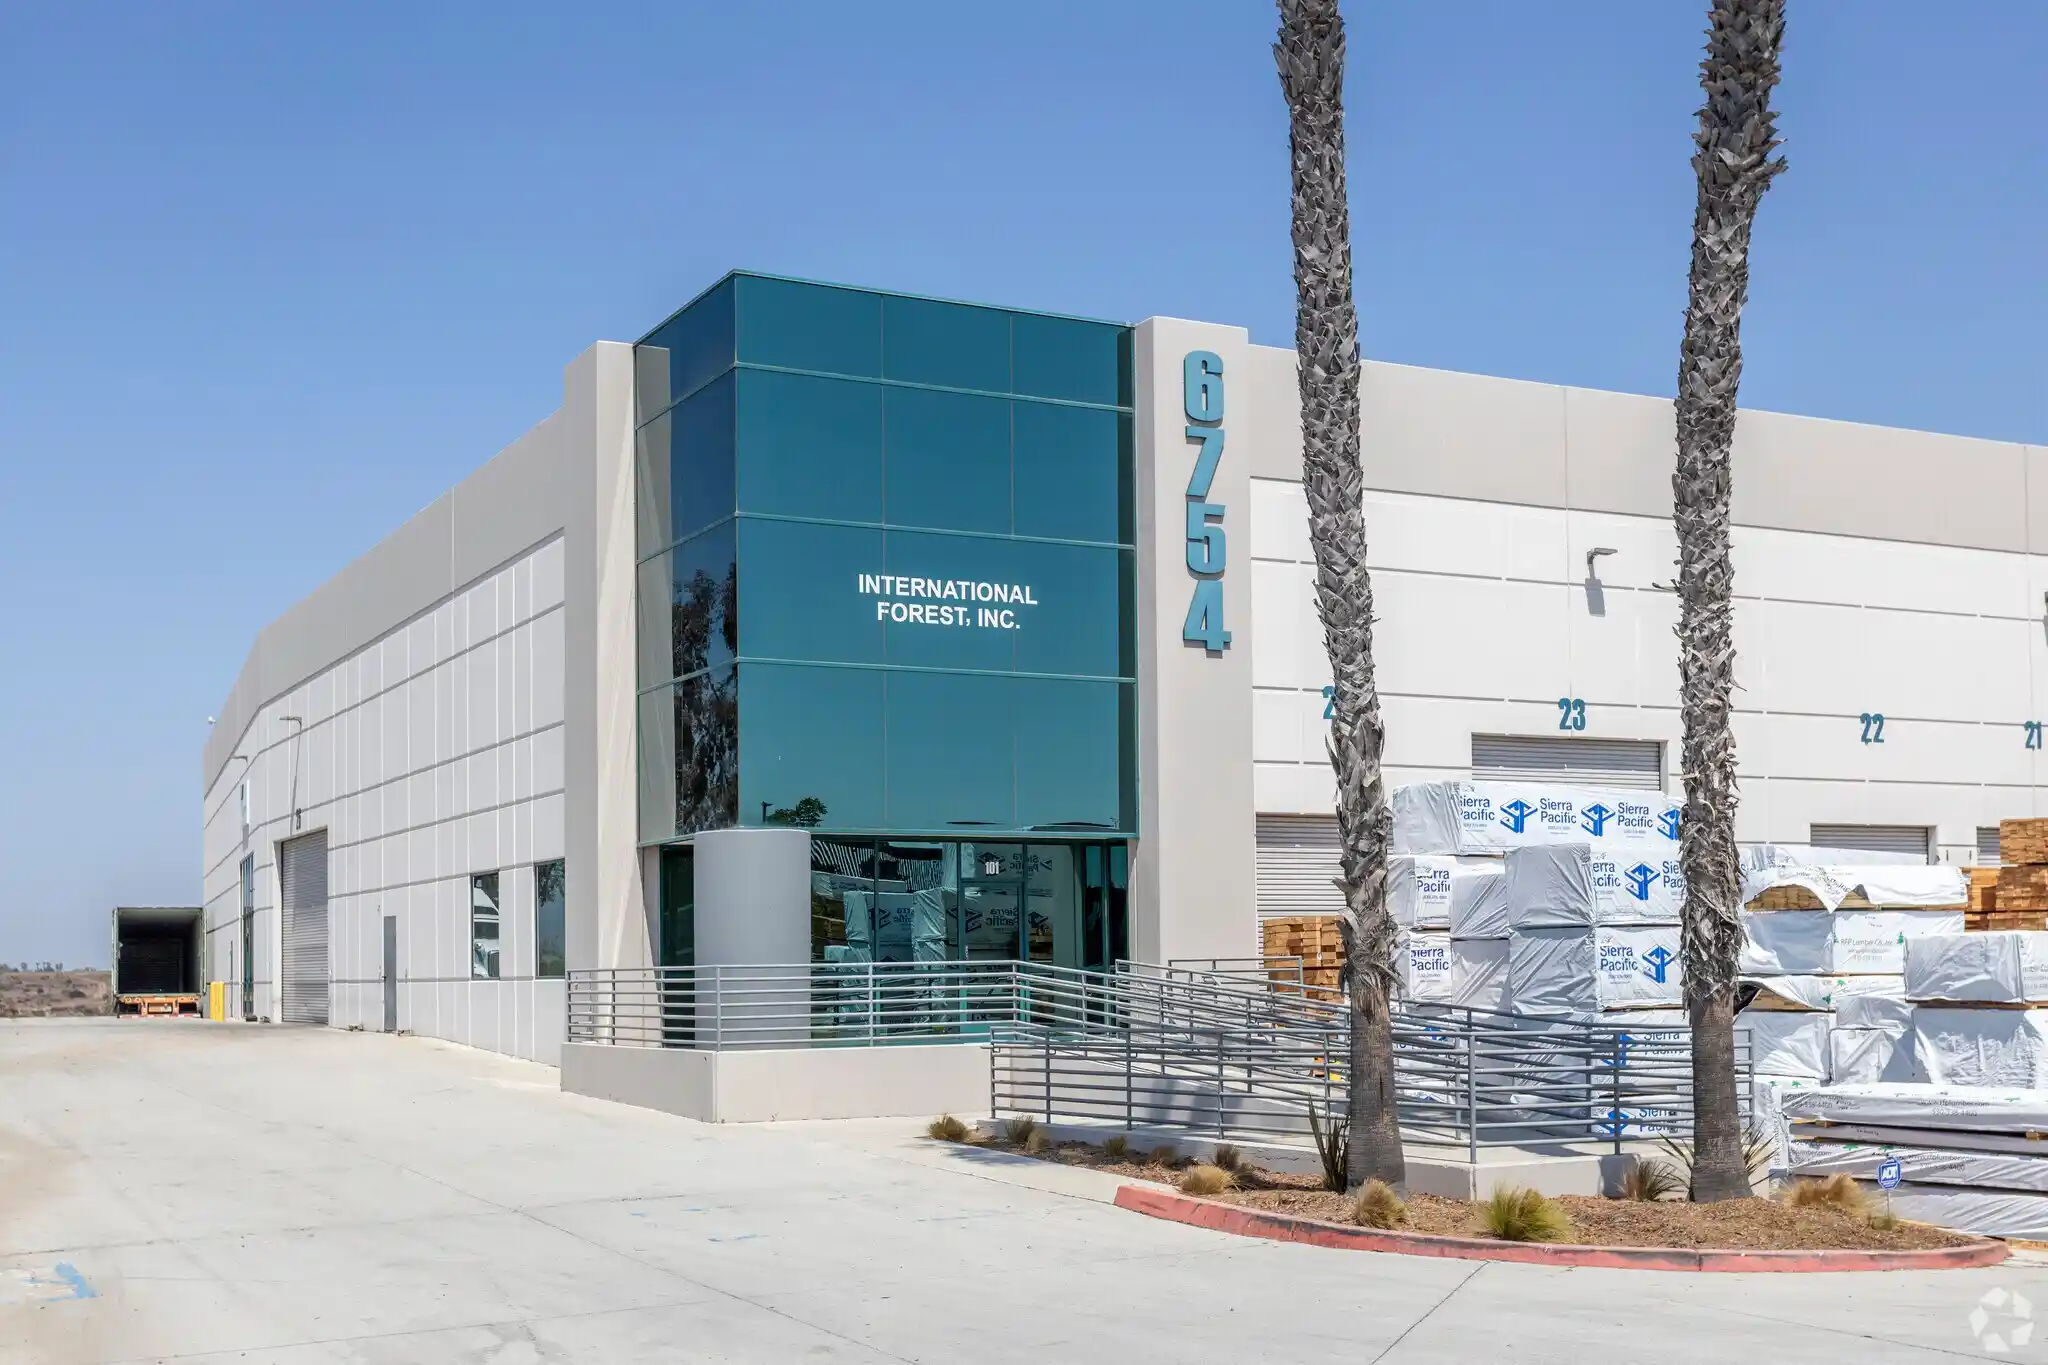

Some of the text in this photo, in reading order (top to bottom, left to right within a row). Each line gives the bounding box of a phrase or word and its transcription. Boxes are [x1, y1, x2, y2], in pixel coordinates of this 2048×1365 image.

[1183, 350, 1232, 650] 6754
[858, 573, 1038, 605] INTERNATIONAL
[877, 601, 1021, 629] FOREST, INC.
[1322, 685, 1337, 719] 2
[1559, 697, 1586, 731] 23
[1859, 712, 1885, 743] 22
[2023, 720, 2042, 750] 21
[1539, 797, 1573, 811] Sierra
[1617, 802, 1649, 815] Sierra
[1540, 810, 1577, 824] Pacific
[1617, 814, 1654, 828] Pacific
[985, 861, 999, 875] 101
[1592, 861, 1615, 873] erra
[1662, 860, 1678, 874] Sie
[1592, 872, 1621, 887] acific
[1600, 947, 1633, 957] Sierra
[1600, 958, 1639, 972] Pacific
[1882, 1166, 1897, 1179] ADT
